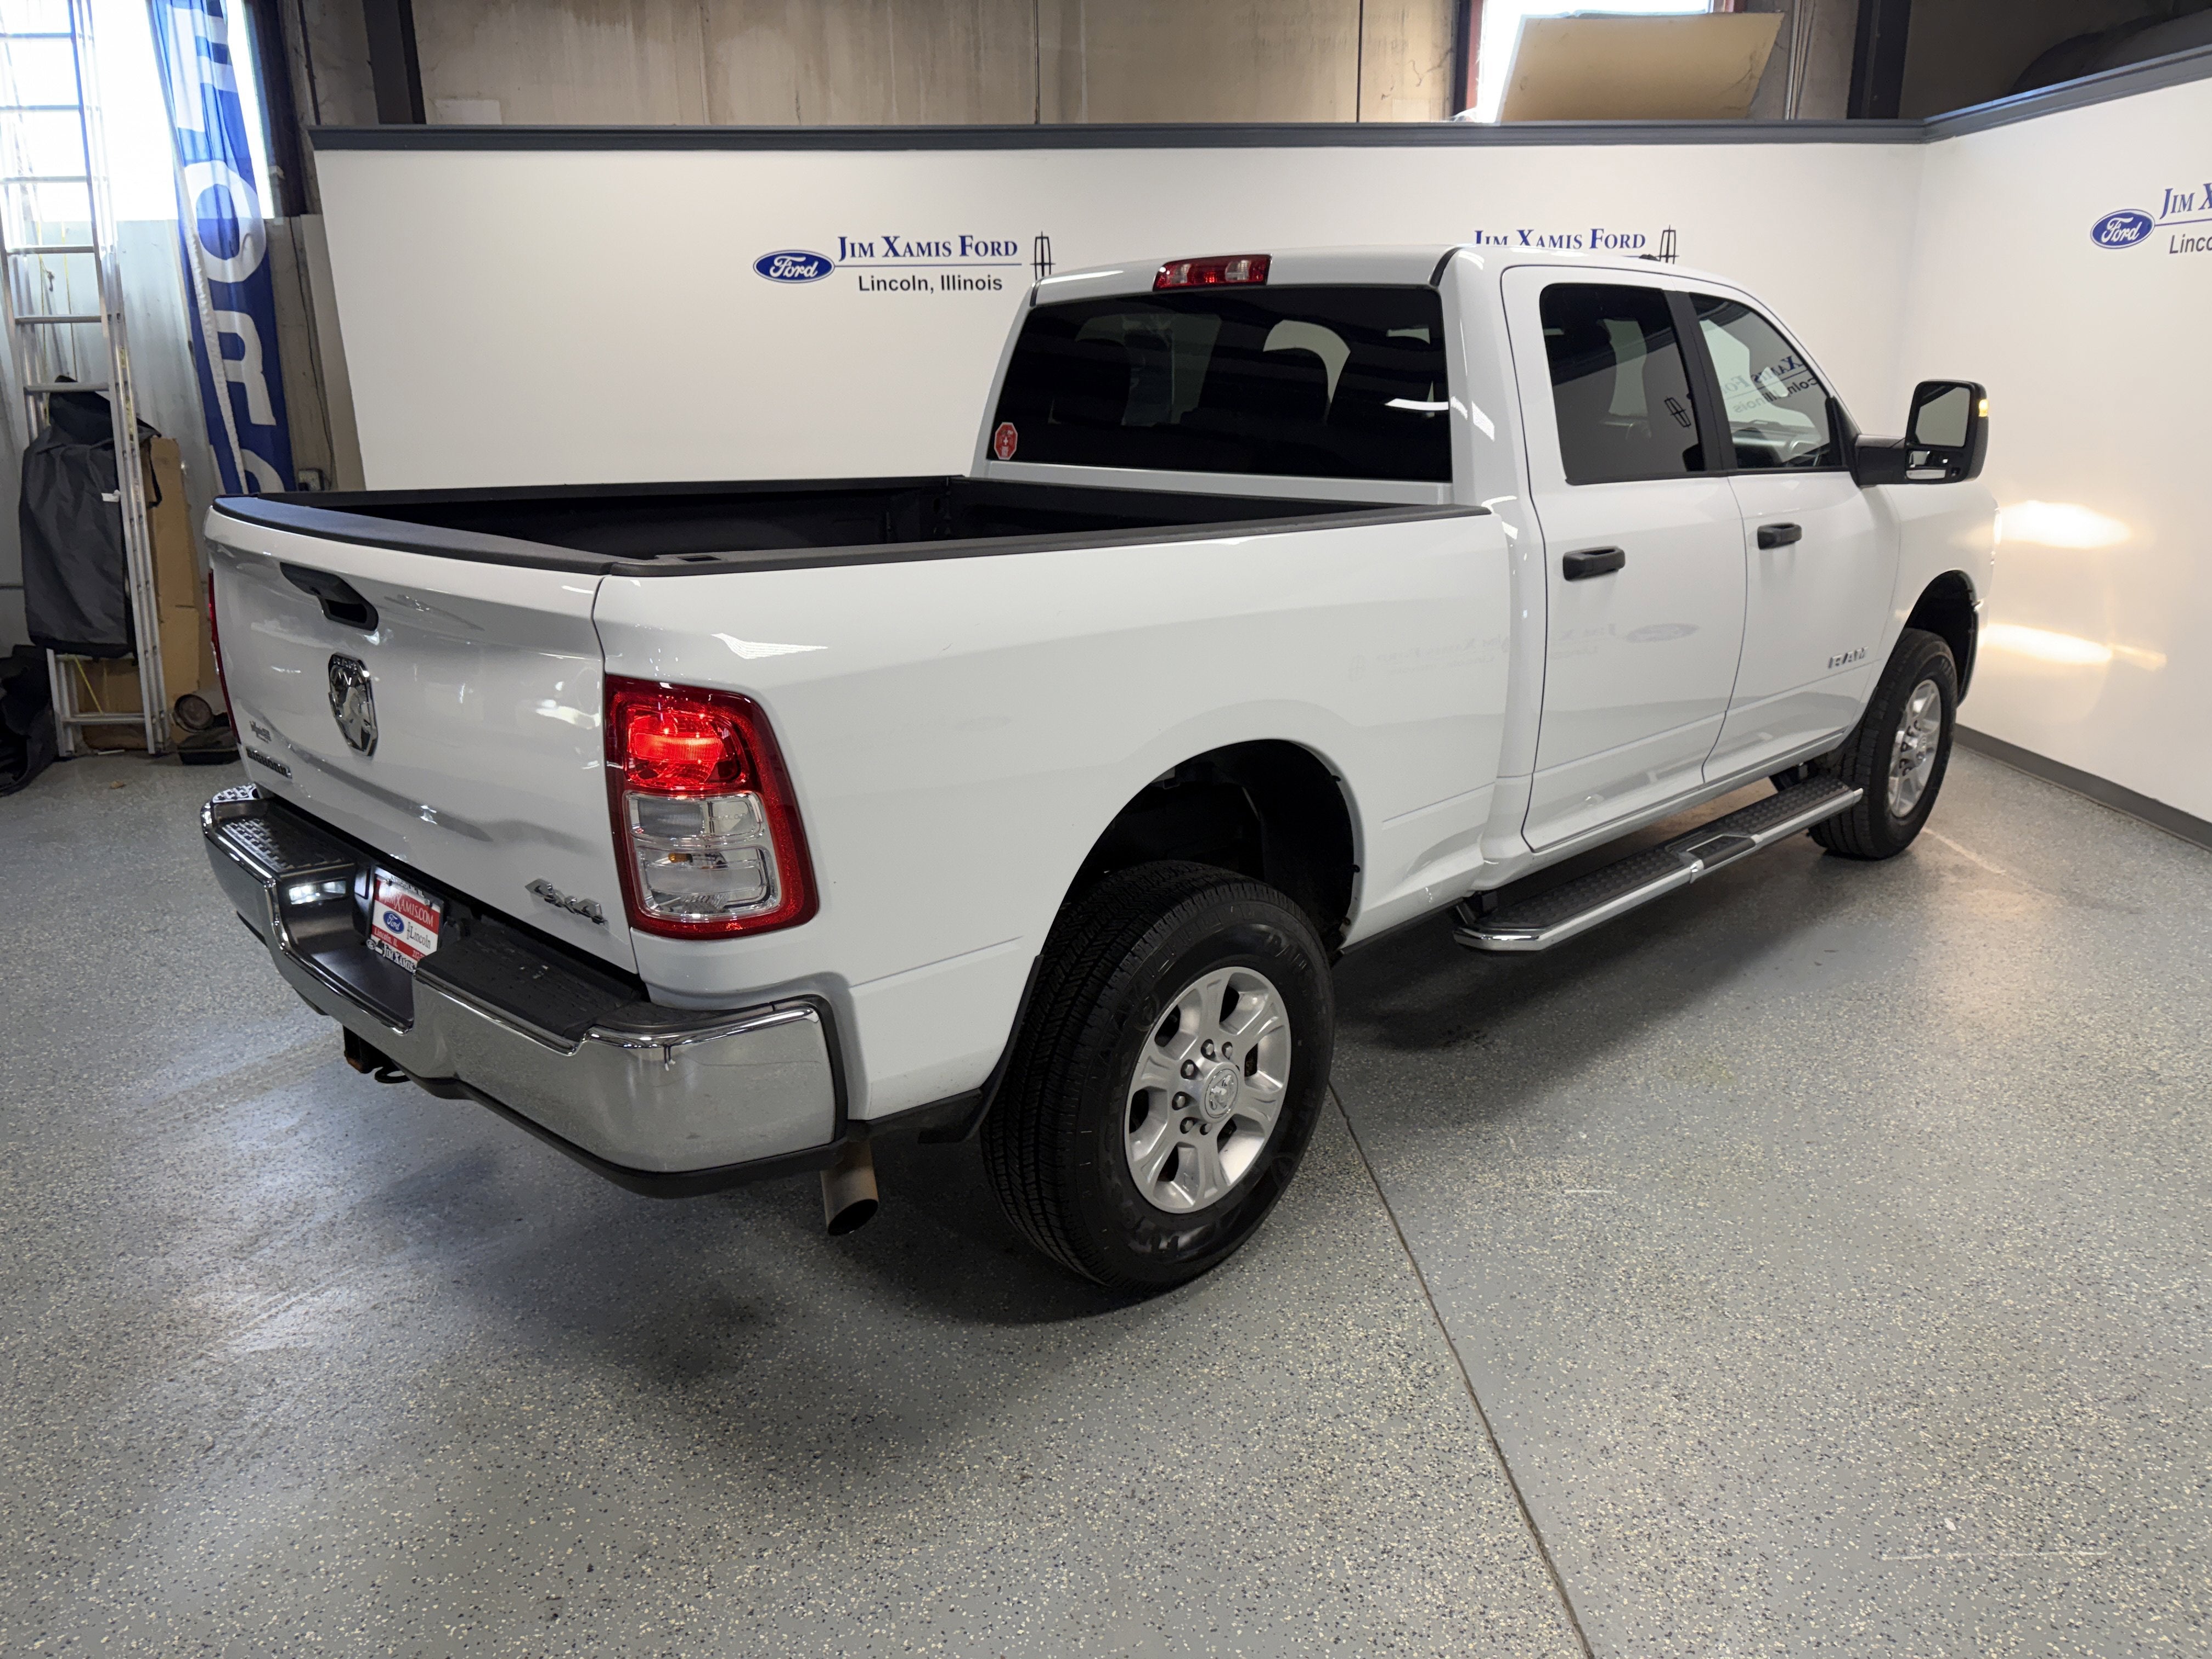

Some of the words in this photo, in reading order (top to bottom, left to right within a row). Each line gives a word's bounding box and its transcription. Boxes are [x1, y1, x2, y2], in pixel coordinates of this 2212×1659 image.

[2159, 188, 2195, 220] JIM
[1516, 229, 1583, 249] XAMIS
[1589, 228, 1645, 249] FORD
[2101, 217, 2142, 242] Ford
[838, 236, 874, 262] JIM
[881, 235, 952, 258] XAMIS
[958, 235, 1018, 257] FORD
[769, 255, 818, 278] Ford
[859, 275, 934, 294] Lincoln,
[941, 275, 1003, 291] Illinois
[386, 913, 402, 930] Ford
[410, 926, 431, 950] Lincoln
